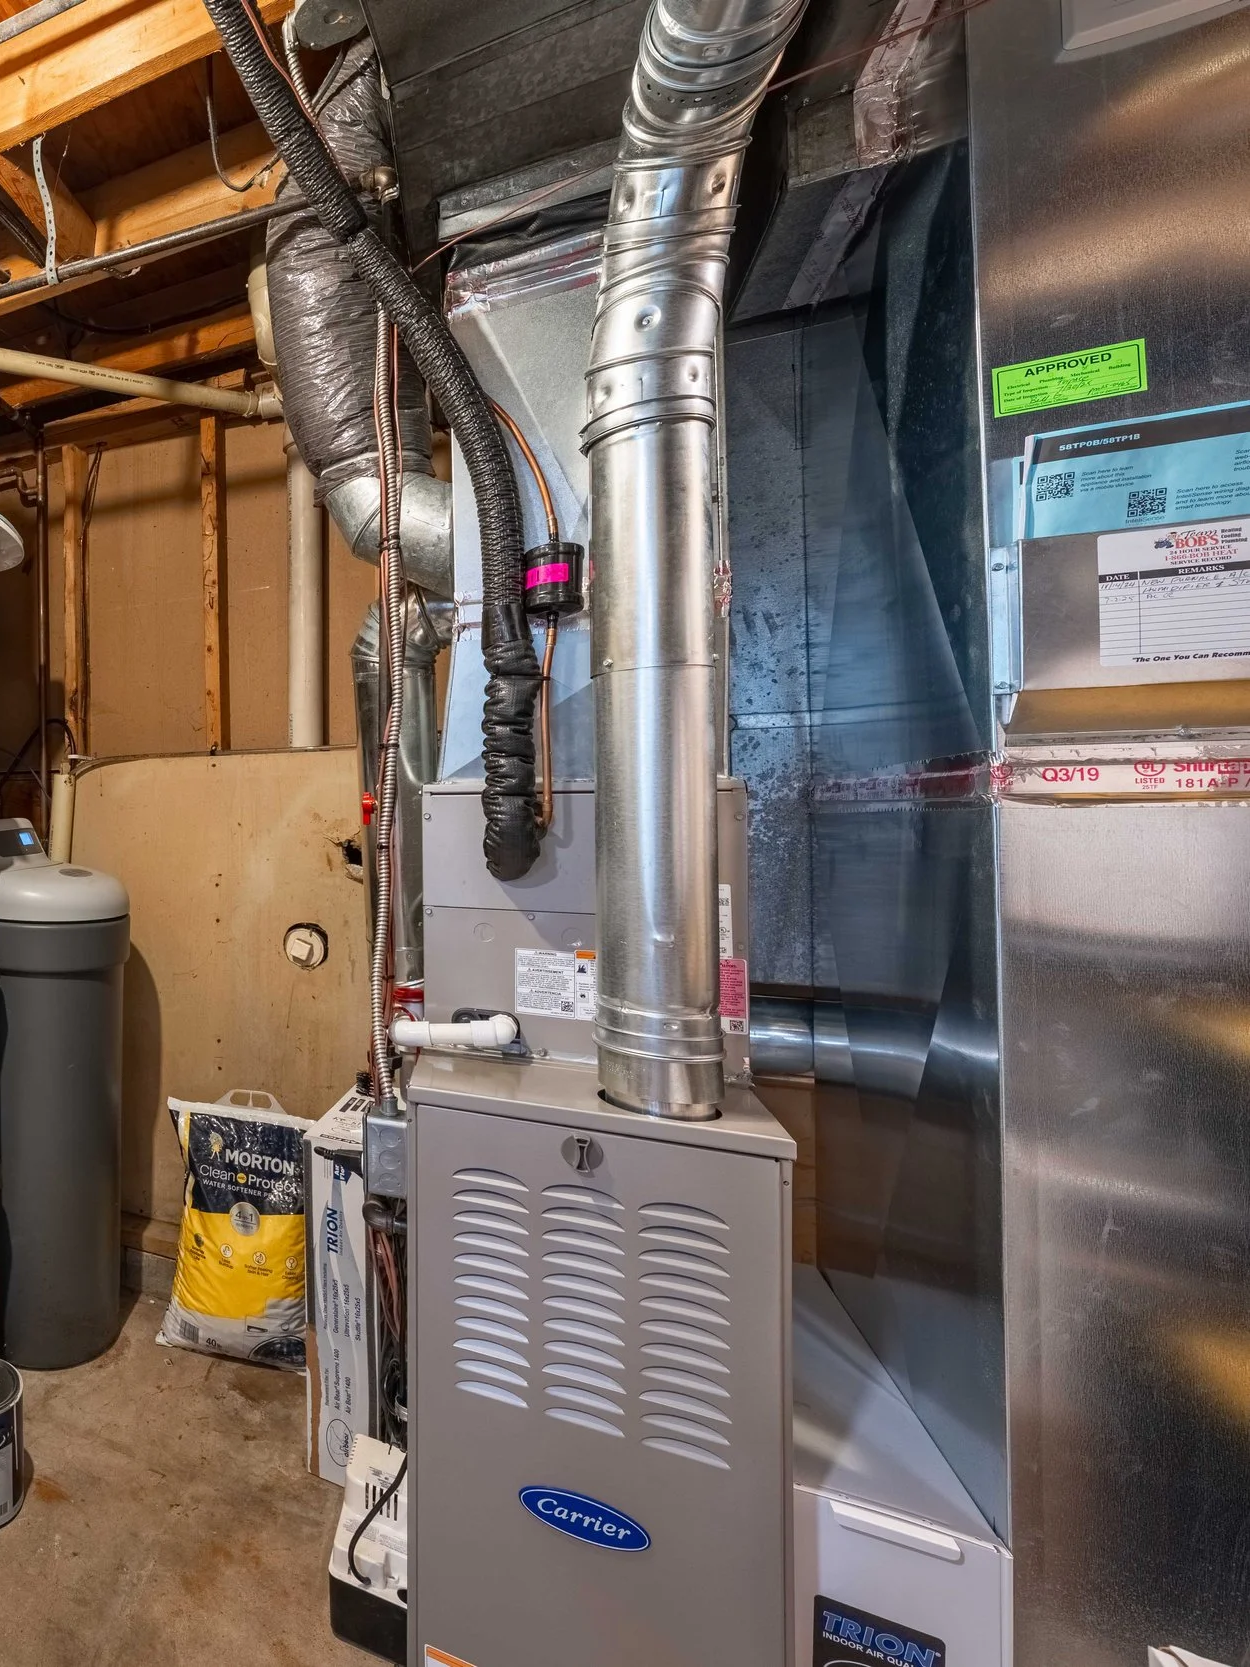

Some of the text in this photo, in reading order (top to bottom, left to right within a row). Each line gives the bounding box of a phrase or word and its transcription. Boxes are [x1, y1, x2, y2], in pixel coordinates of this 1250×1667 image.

[1024, 352, 1111, 377] APPROVED
[1071, 368, 1099, 377] Mechanical
[1059, 434, 1140, 451] 58TP0B/58TP1B
[1176, 536, 1219, 549] BOB'S
[1181, 530, 1218, 539] Team
[1165, 551, 1211, 561] 1-866-BOB
[1202, 544, 1232, 552] SERVICE
[1178, 565, 1224, 574] REMARKS
[1042, 767, 1100, 783] Q3/19
[1175, 778, 1238, 788] 181A-P
[225, 1149, 294, 1176] MORTON
[200, 1165, 297, 1193] Clean Protect
[202, 1179, 261, 1196] WATER SOFTENER
[327, 1207, 338, 1254] TRION
[206, 1338, 216, 1348] 40
[537, 1498, 631, 1540] Carrier
[822, 1610, 935, 1667] TRION
[822, 1631, 884, 1660] INDOOR AIR
